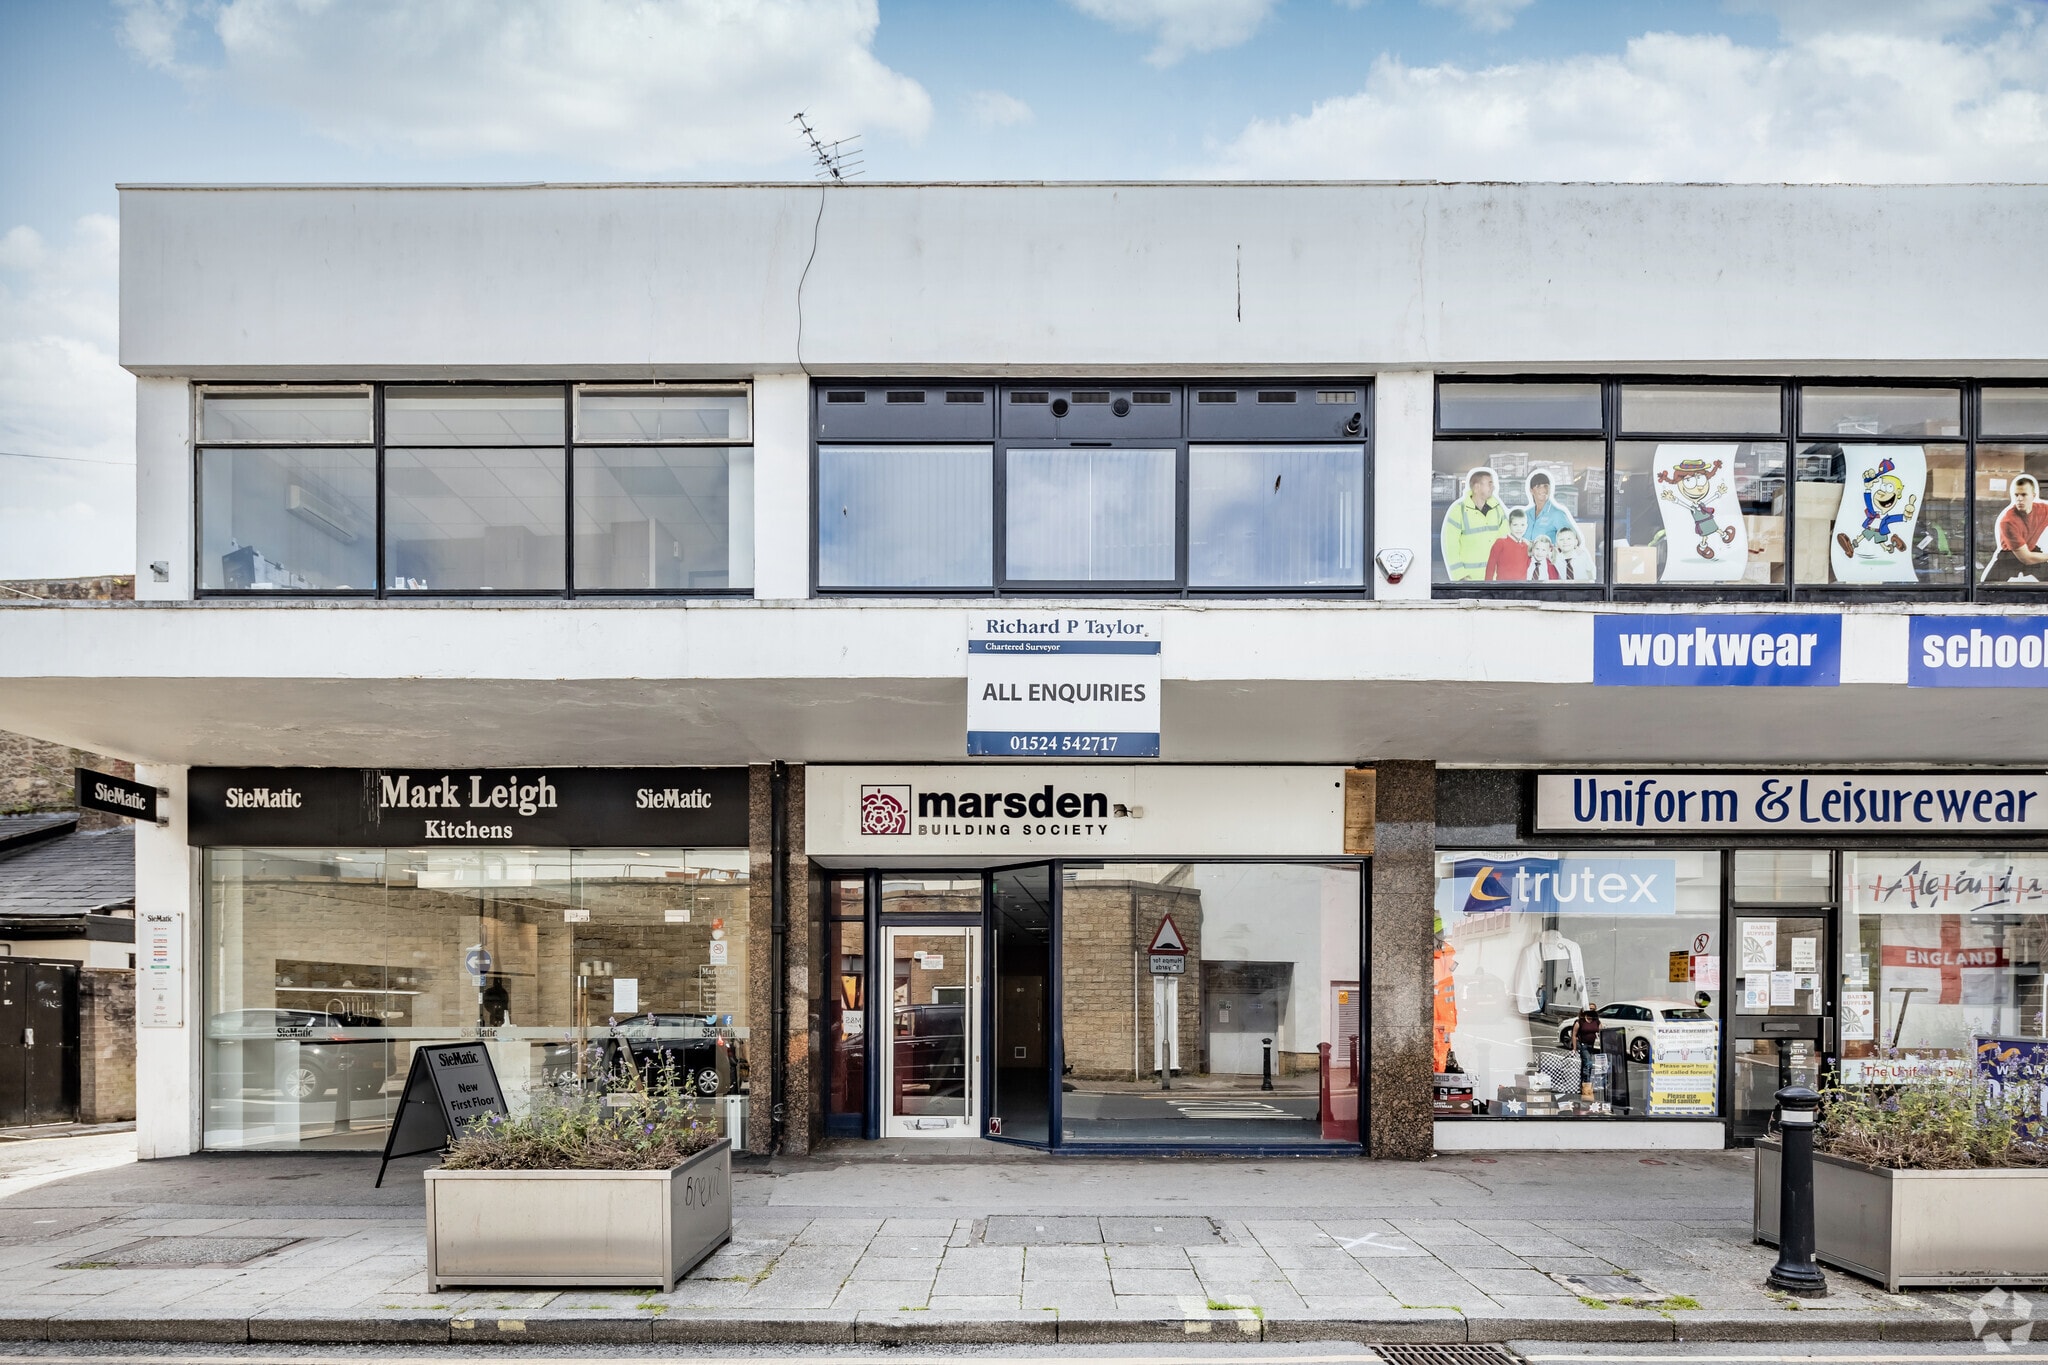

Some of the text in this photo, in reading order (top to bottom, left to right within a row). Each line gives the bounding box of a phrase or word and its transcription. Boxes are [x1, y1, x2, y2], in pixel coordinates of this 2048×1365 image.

[987, 619, 1144, 638] Richard P Taylor
[985, 642, 1061, 654] Chartered Surveyor
[1619, 628, 1818, 667] workwear
[983, 684, 1146, 704] ALL ENQUIRIES
[1010, 736, 1118, 752] 01524 542717
[95, 782, 146, 811] SieMatic
[225, 787, 302, 809] SieMatic
[380, 775, 558, 816] Mark Leigh
[635, 788, 712, 809] SieMatic
[918, 785, 1108, 818] marsden
[1574, 779, 2038, 826] Uniform & Leisurewear
[424, 820, 513, 839] Kitchens
[918, 825, 1108, 836] BUILDING SOCIETY
[1515, 866, 1658, 903] trutex
[1906, 949, 1997, 965] ENGLAND
[276, 1027, 313, 1038] SieMatic
[461, 1027, 498, 1038] SieMatic
[438, 1051, 479, 1067] SieMatic
[1865, 1066, 1887, 1076] The
[1891, 1066, 1941, 1077] Unif
[458, 1083, 478, 1093] New
[450, 1096, 495, 1111] First Floor
